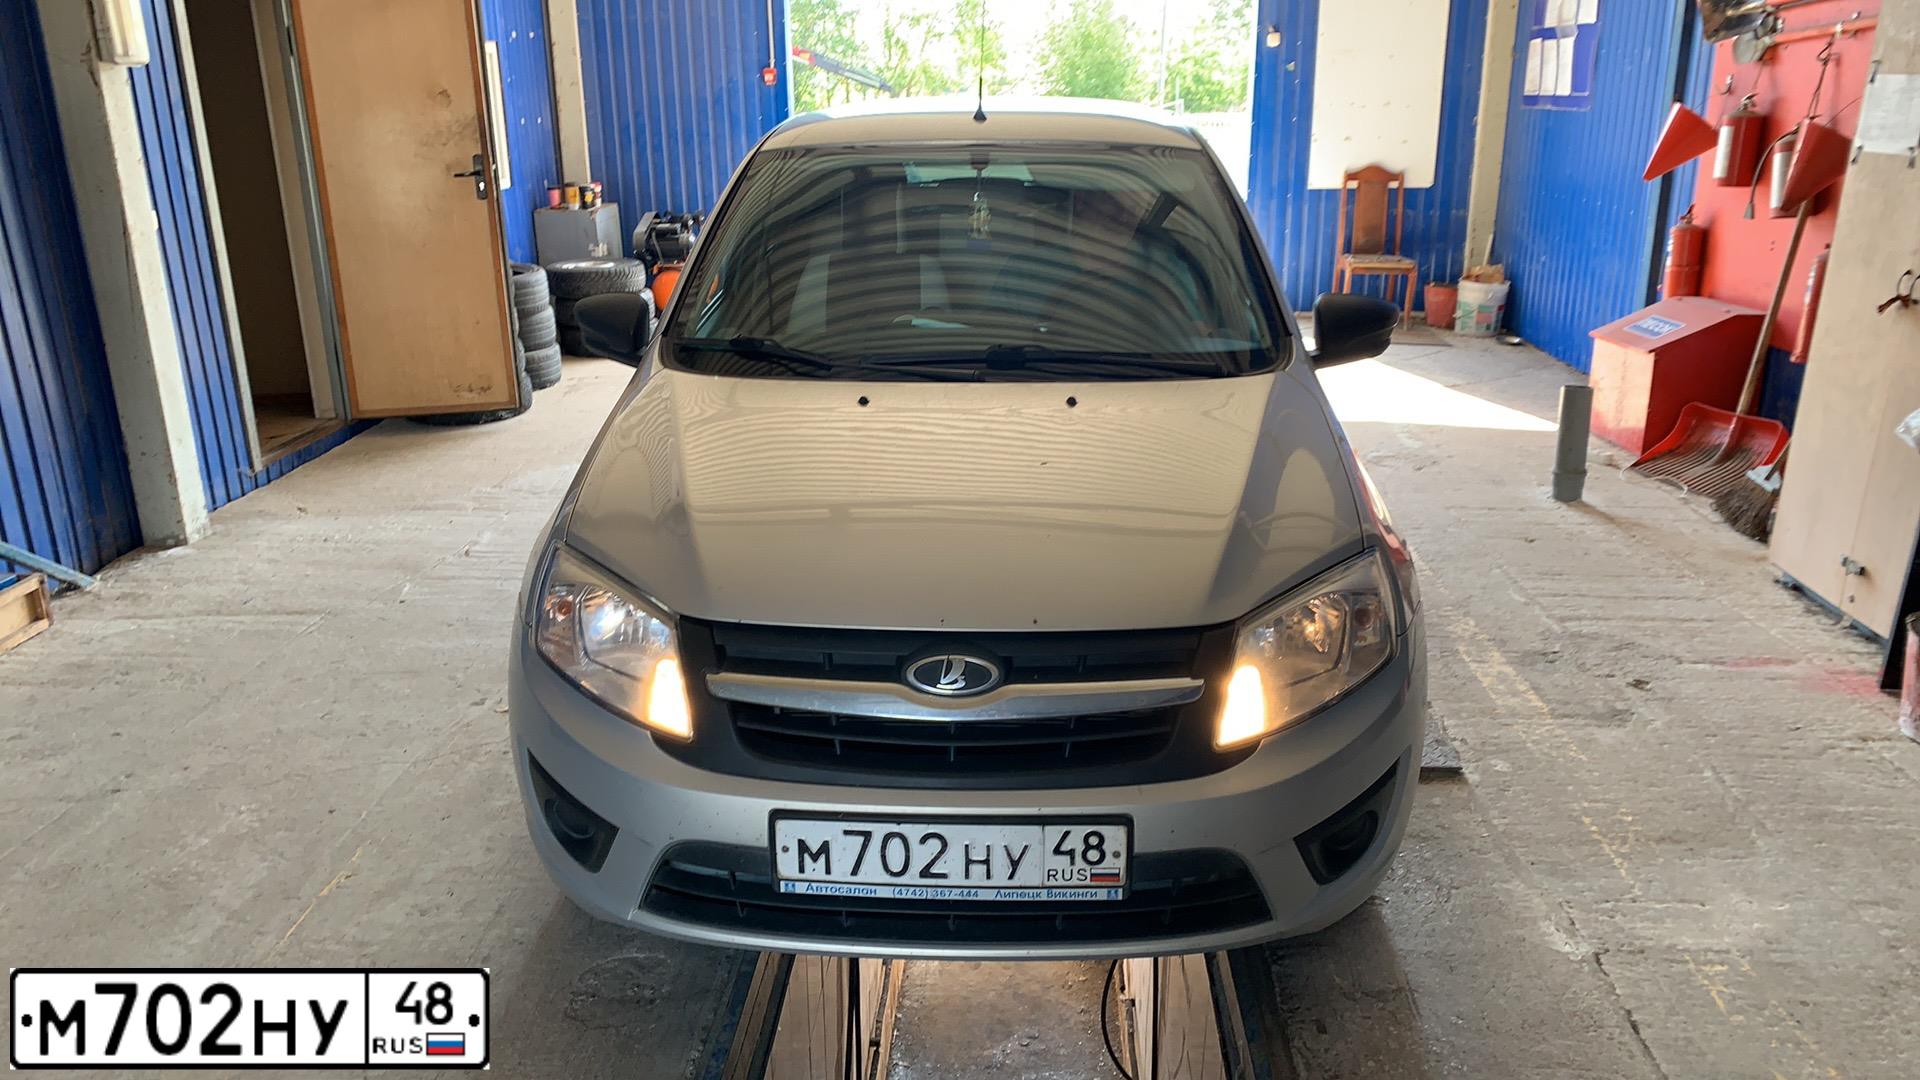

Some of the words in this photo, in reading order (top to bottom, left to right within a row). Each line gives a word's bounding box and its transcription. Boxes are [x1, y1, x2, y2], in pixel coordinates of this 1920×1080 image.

[1052, 830, 1106, 867] 48
[1047, 868, 1088, 882] RUS
[805, 882, 877, 896] Автосалон
[994, 889, 1042, 900] Липецк
[1046, 888, 1098, 899] Викинги
